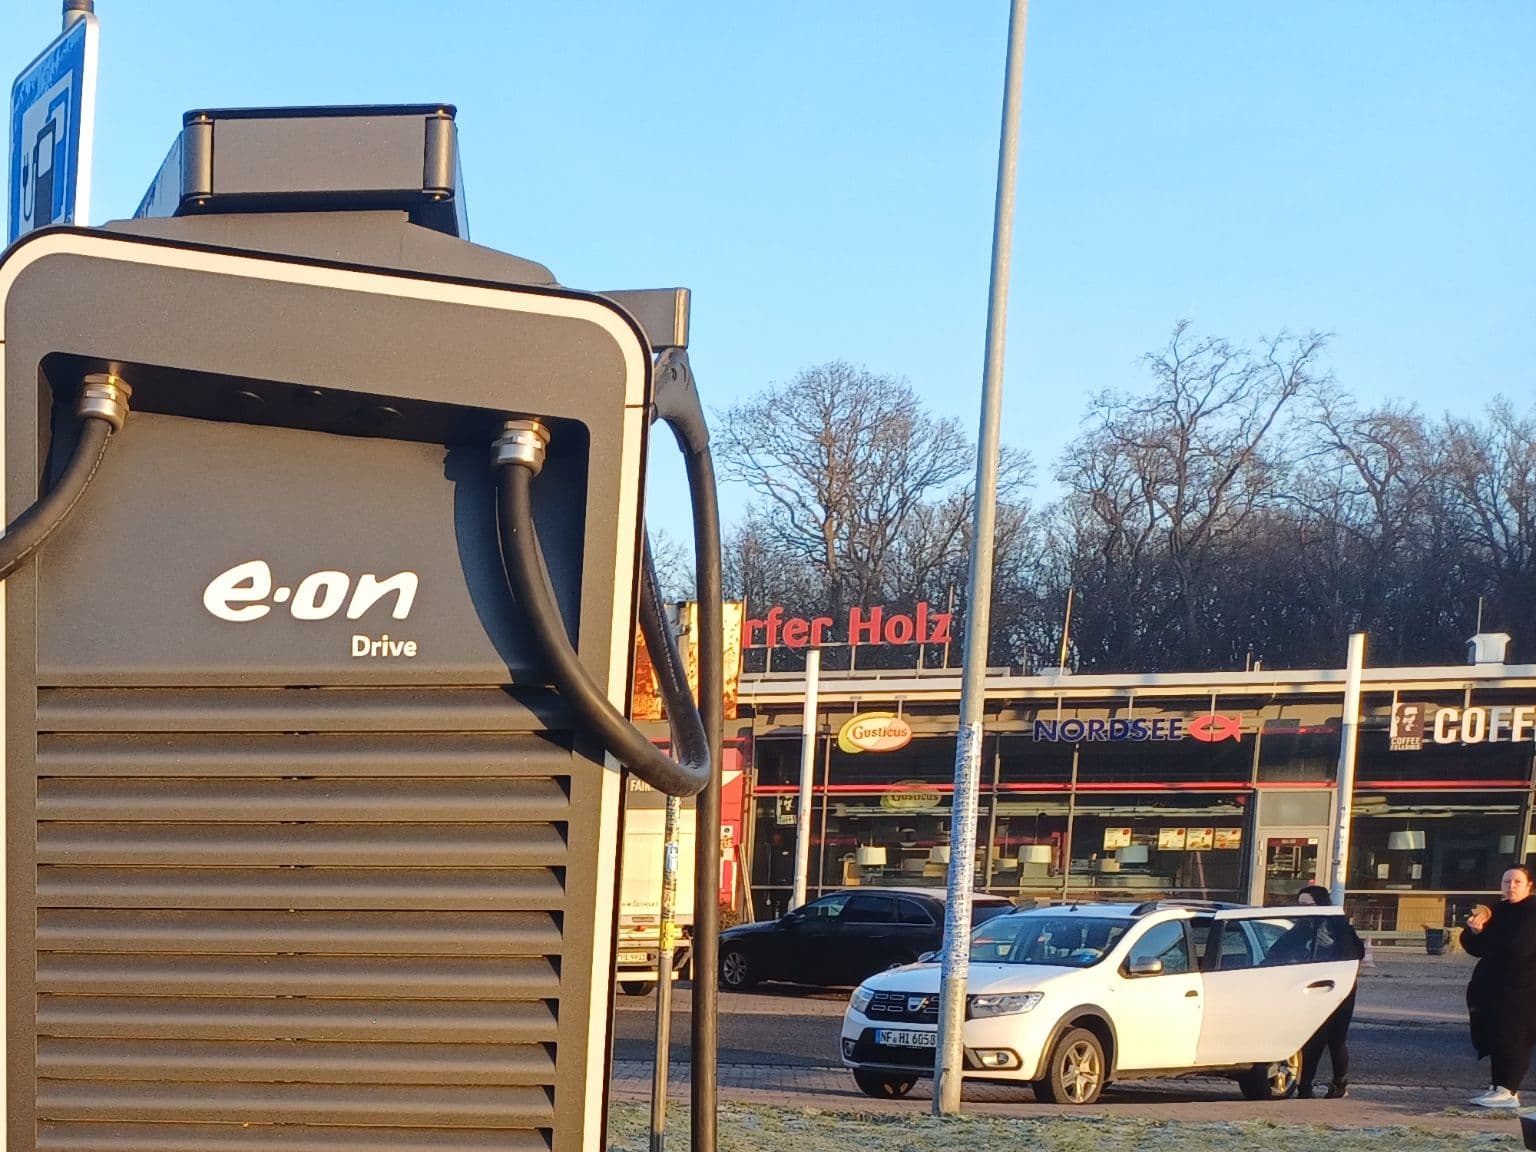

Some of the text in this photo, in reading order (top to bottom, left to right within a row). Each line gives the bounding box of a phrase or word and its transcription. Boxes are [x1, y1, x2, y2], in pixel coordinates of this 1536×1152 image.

[848, 602, 953, 645] Holz
[352, 635, 417, 657] Drive
[852, 725, 907, 740] Gusticus
[1033, 717, 1183, 742] NORDSEE
